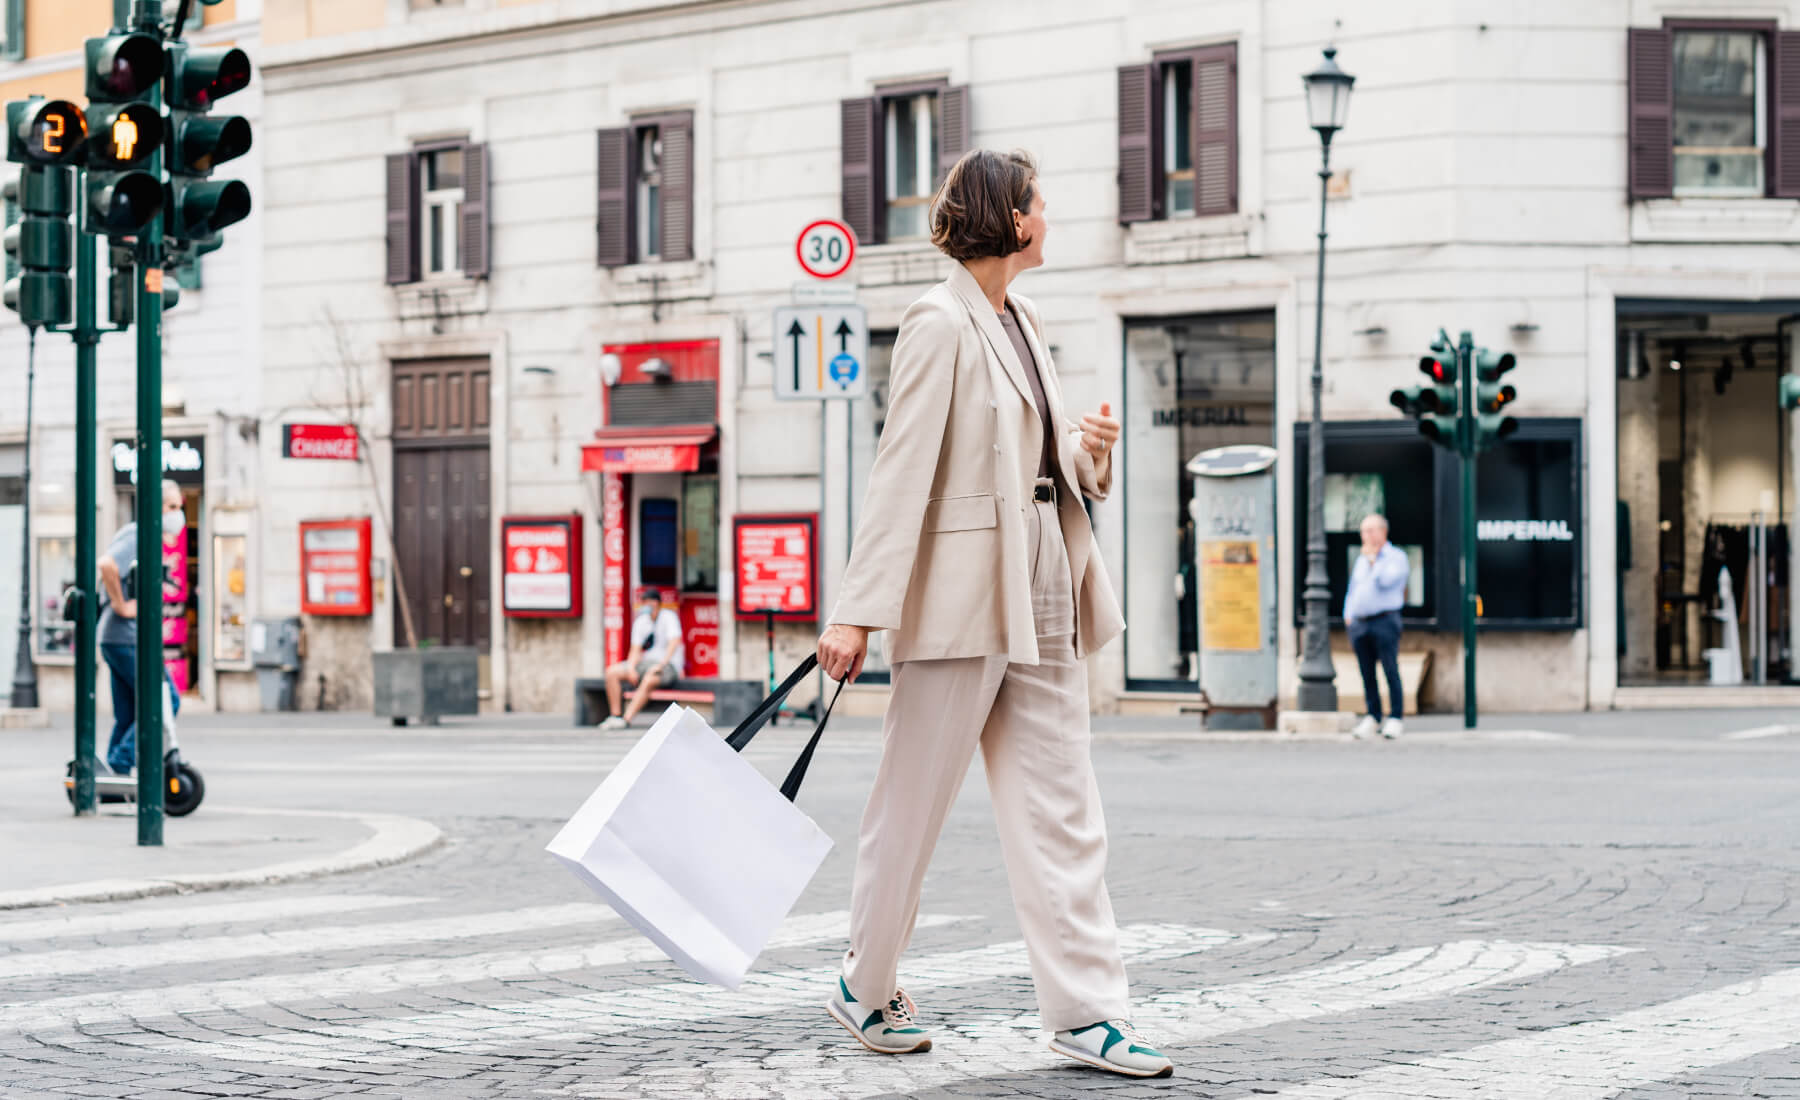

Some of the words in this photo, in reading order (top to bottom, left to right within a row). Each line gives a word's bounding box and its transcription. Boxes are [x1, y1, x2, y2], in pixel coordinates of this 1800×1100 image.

[43, 114, 64, 152] 2
[810, 235, 842, 263] 30
[1152, 408, 1250, 426] IMPERIAL
[291, 438, 357, 458] CHANGE
[1477, 519, 1573, 540] IMPERIAL
